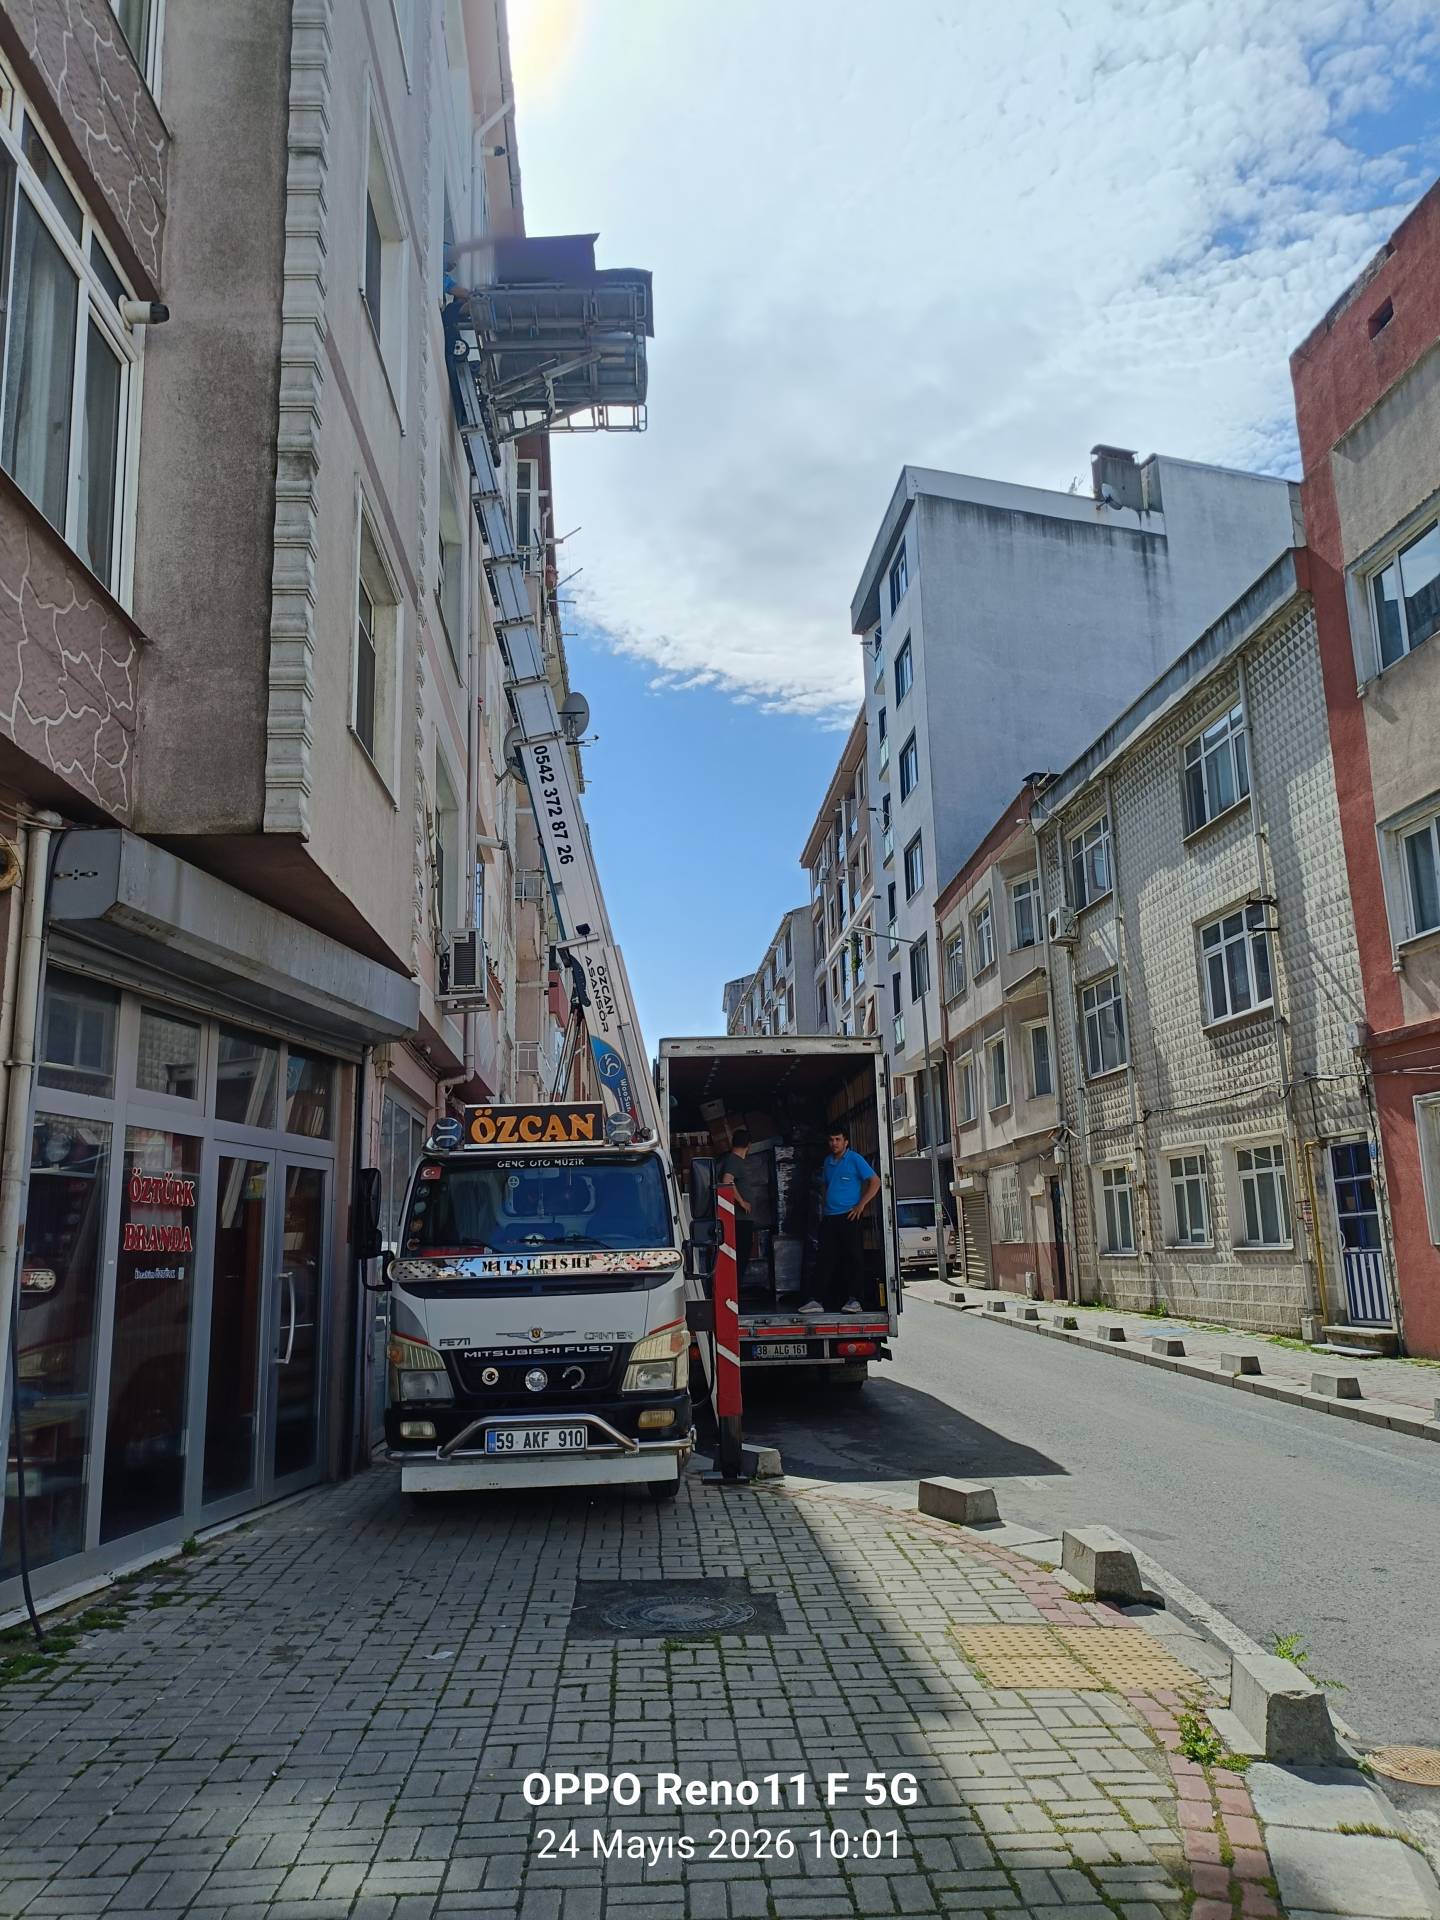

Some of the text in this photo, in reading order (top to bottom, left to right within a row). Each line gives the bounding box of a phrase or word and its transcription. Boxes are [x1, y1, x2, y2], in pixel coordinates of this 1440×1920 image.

[534, 745, 574, 865] 0542 372 87 26
[585, 955, 609, 1033] ASANSÖR
[597, 965, 615, 1015] ÖZCAN
[471, 1108, 595, 1143] ÖZCAN
[497, 1160, 525, 1168] GENÇ
[129, 1168, 196, 1207] ÖZTÜRK
[123, 1223, 193, 1252] BRANDA
[481, 1258, 590, 1273] MITSUBISHI
[464, 1345, 614, 1358] MITSUBISHI FUSO
[774, 1345, 790, 1355] ALG
[496, 1432, 514, 1450] 59
[523, 1431, 550, 1449] AKF
[558, 1430, 583, 1448] 910
